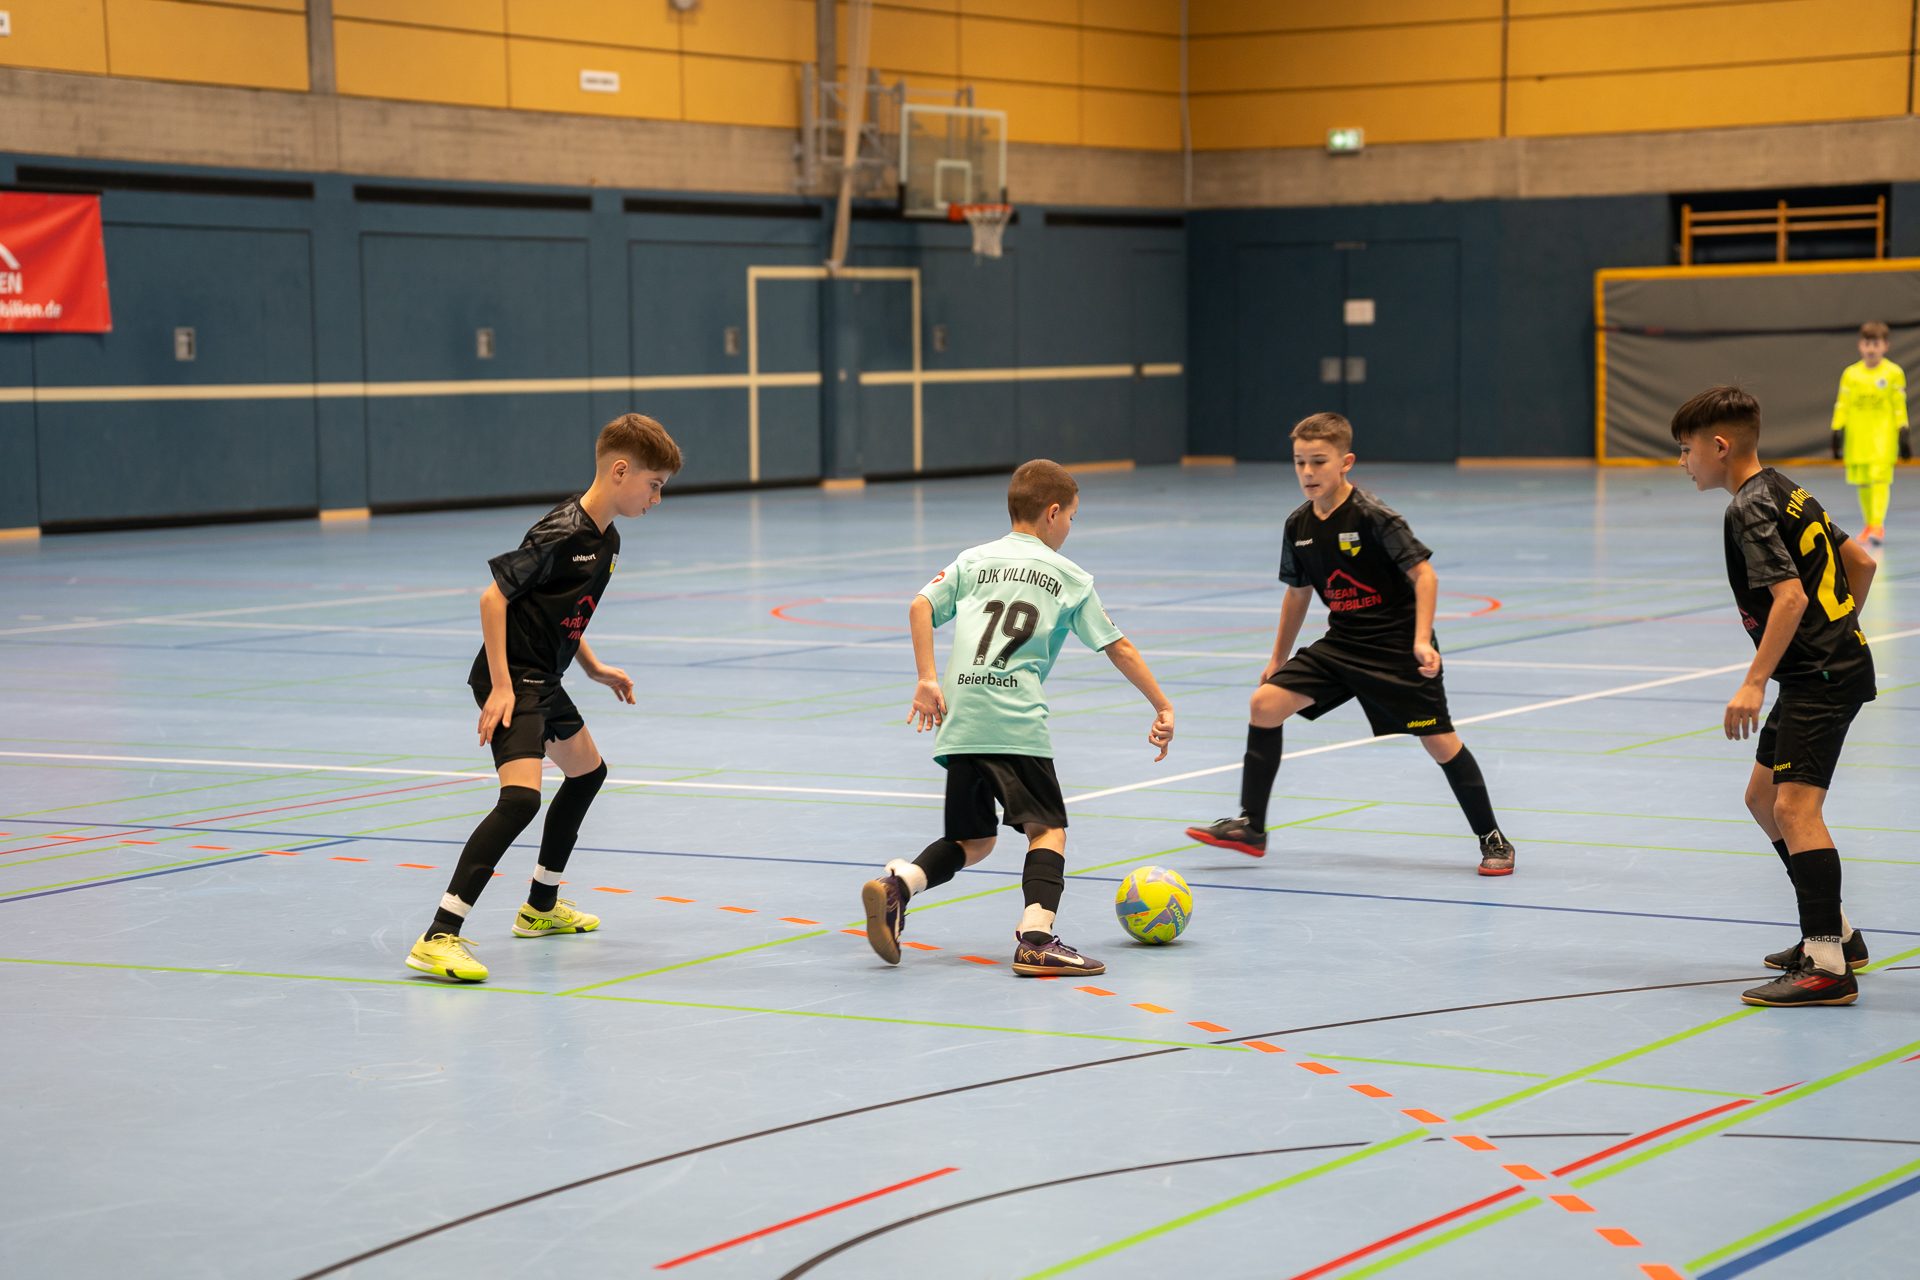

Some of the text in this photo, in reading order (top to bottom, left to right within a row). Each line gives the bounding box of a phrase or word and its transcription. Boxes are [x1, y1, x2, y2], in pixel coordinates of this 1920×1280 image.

[1799, 511, 1856, 622] 2
[977, 567, 1062, 598] DJK VILLINGEN
[972, 599, 1041, 671] 19
[957, 672, 1018, 688] Beierbach
[1809, 935, 1841, 944] adidas
